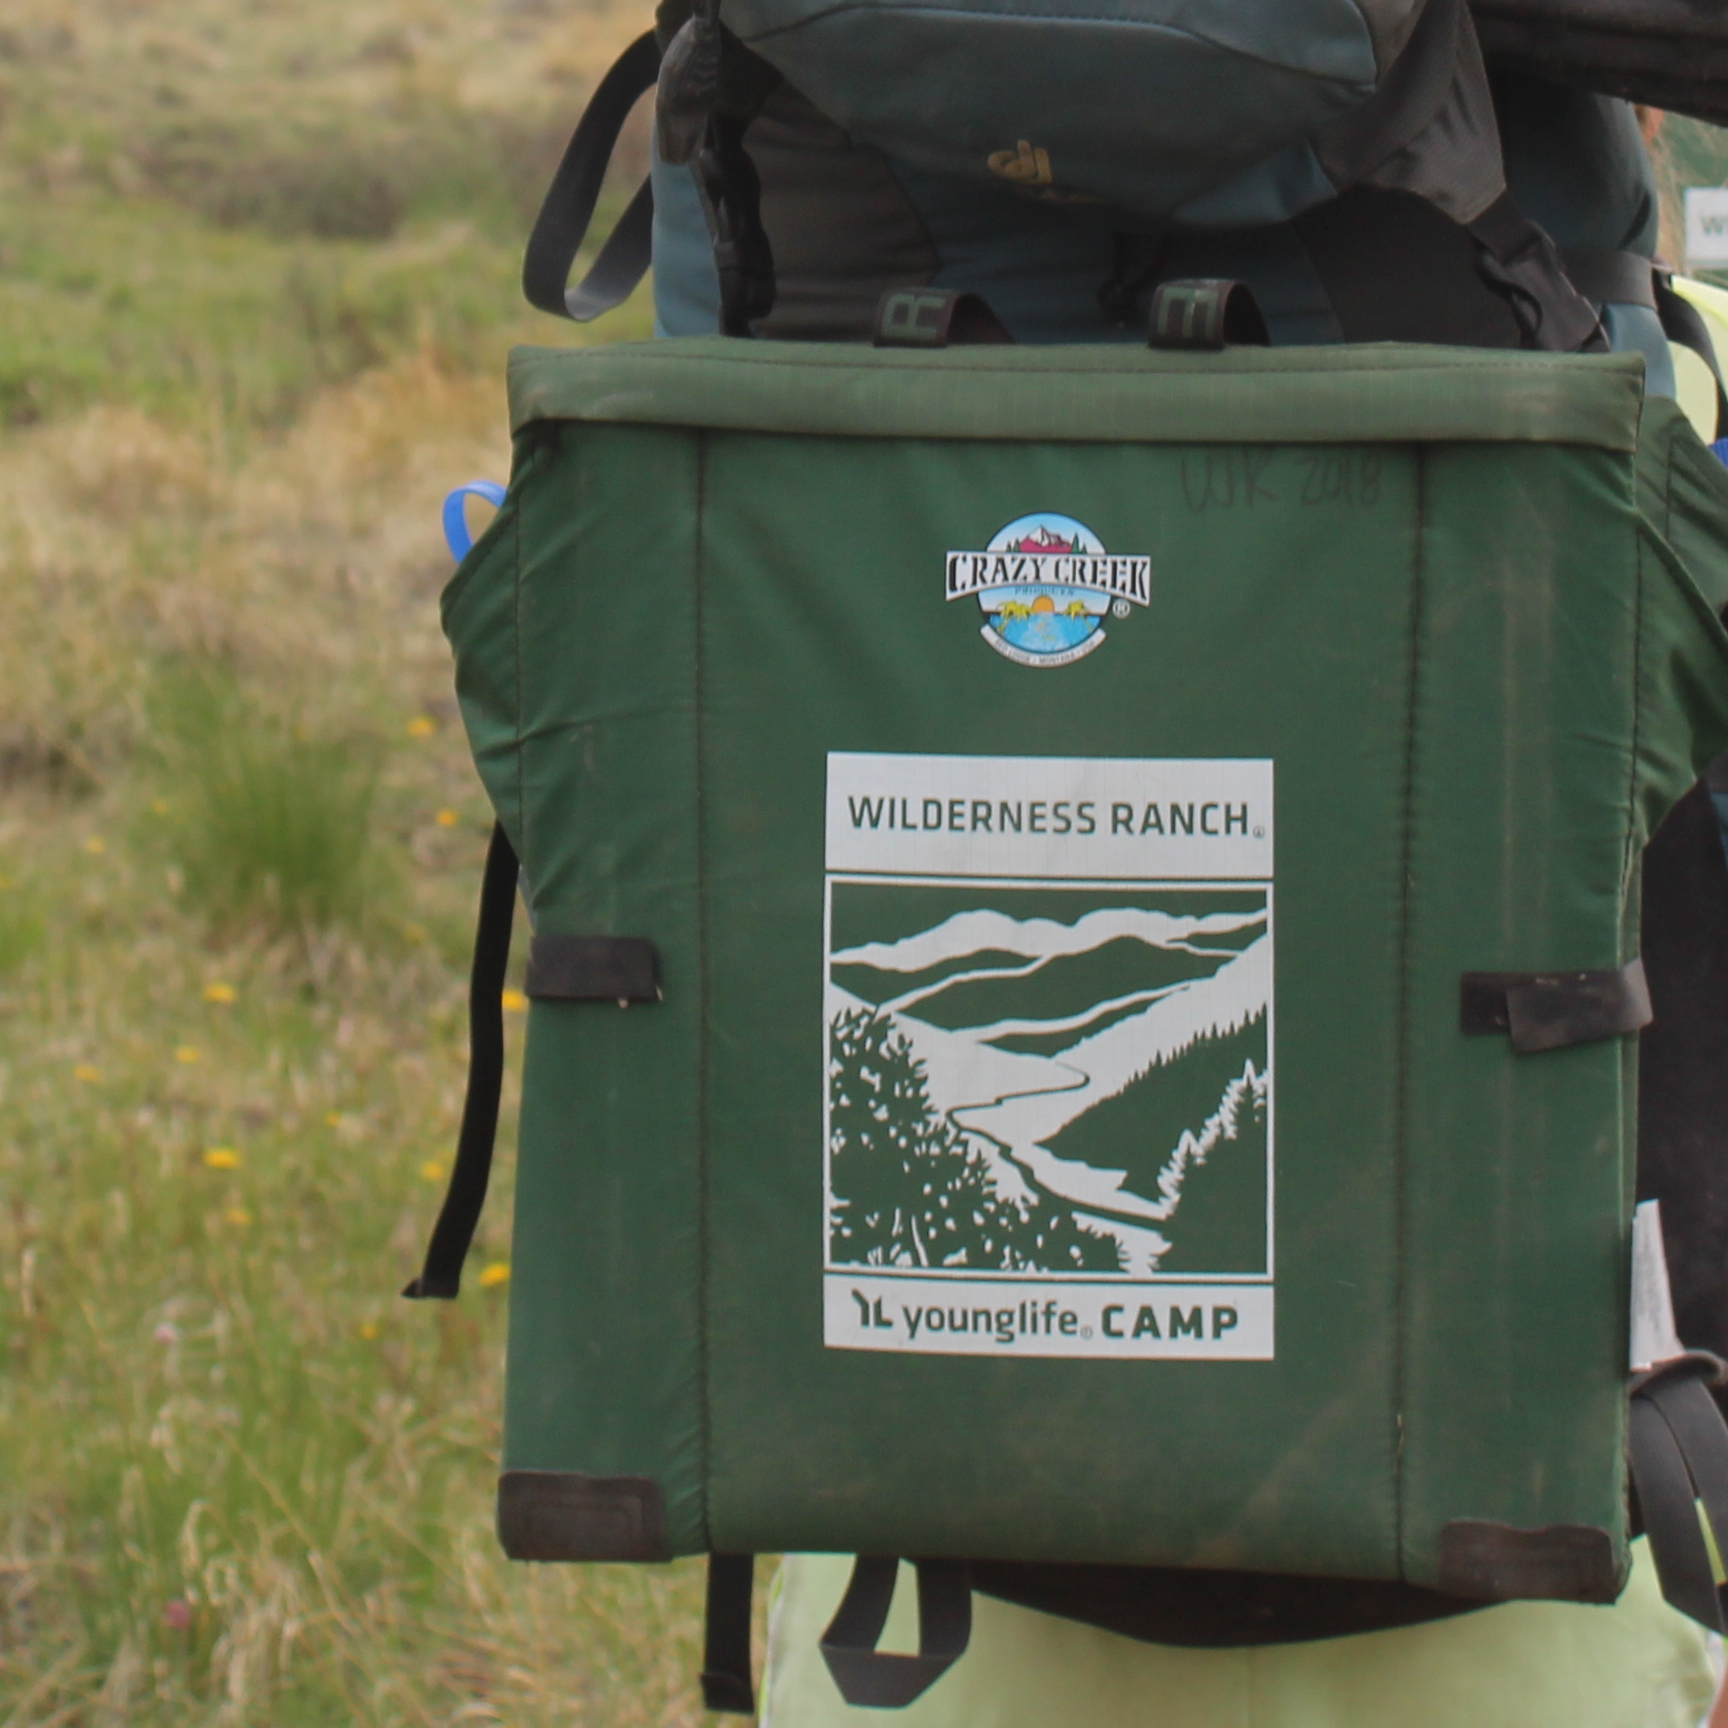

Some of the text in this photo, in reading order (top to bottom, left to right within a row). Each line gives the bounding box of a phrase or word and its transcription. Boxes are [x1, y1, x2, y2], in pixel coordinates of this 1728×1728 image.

[948, 554, 1148, 601] CRAZY CREEK
[847, 795, 1249, 837] WILDERNESS RANCH
[902, 1300, 1079, 1344] younglife
[1101, 1303, 1240, 1340] CAMP
